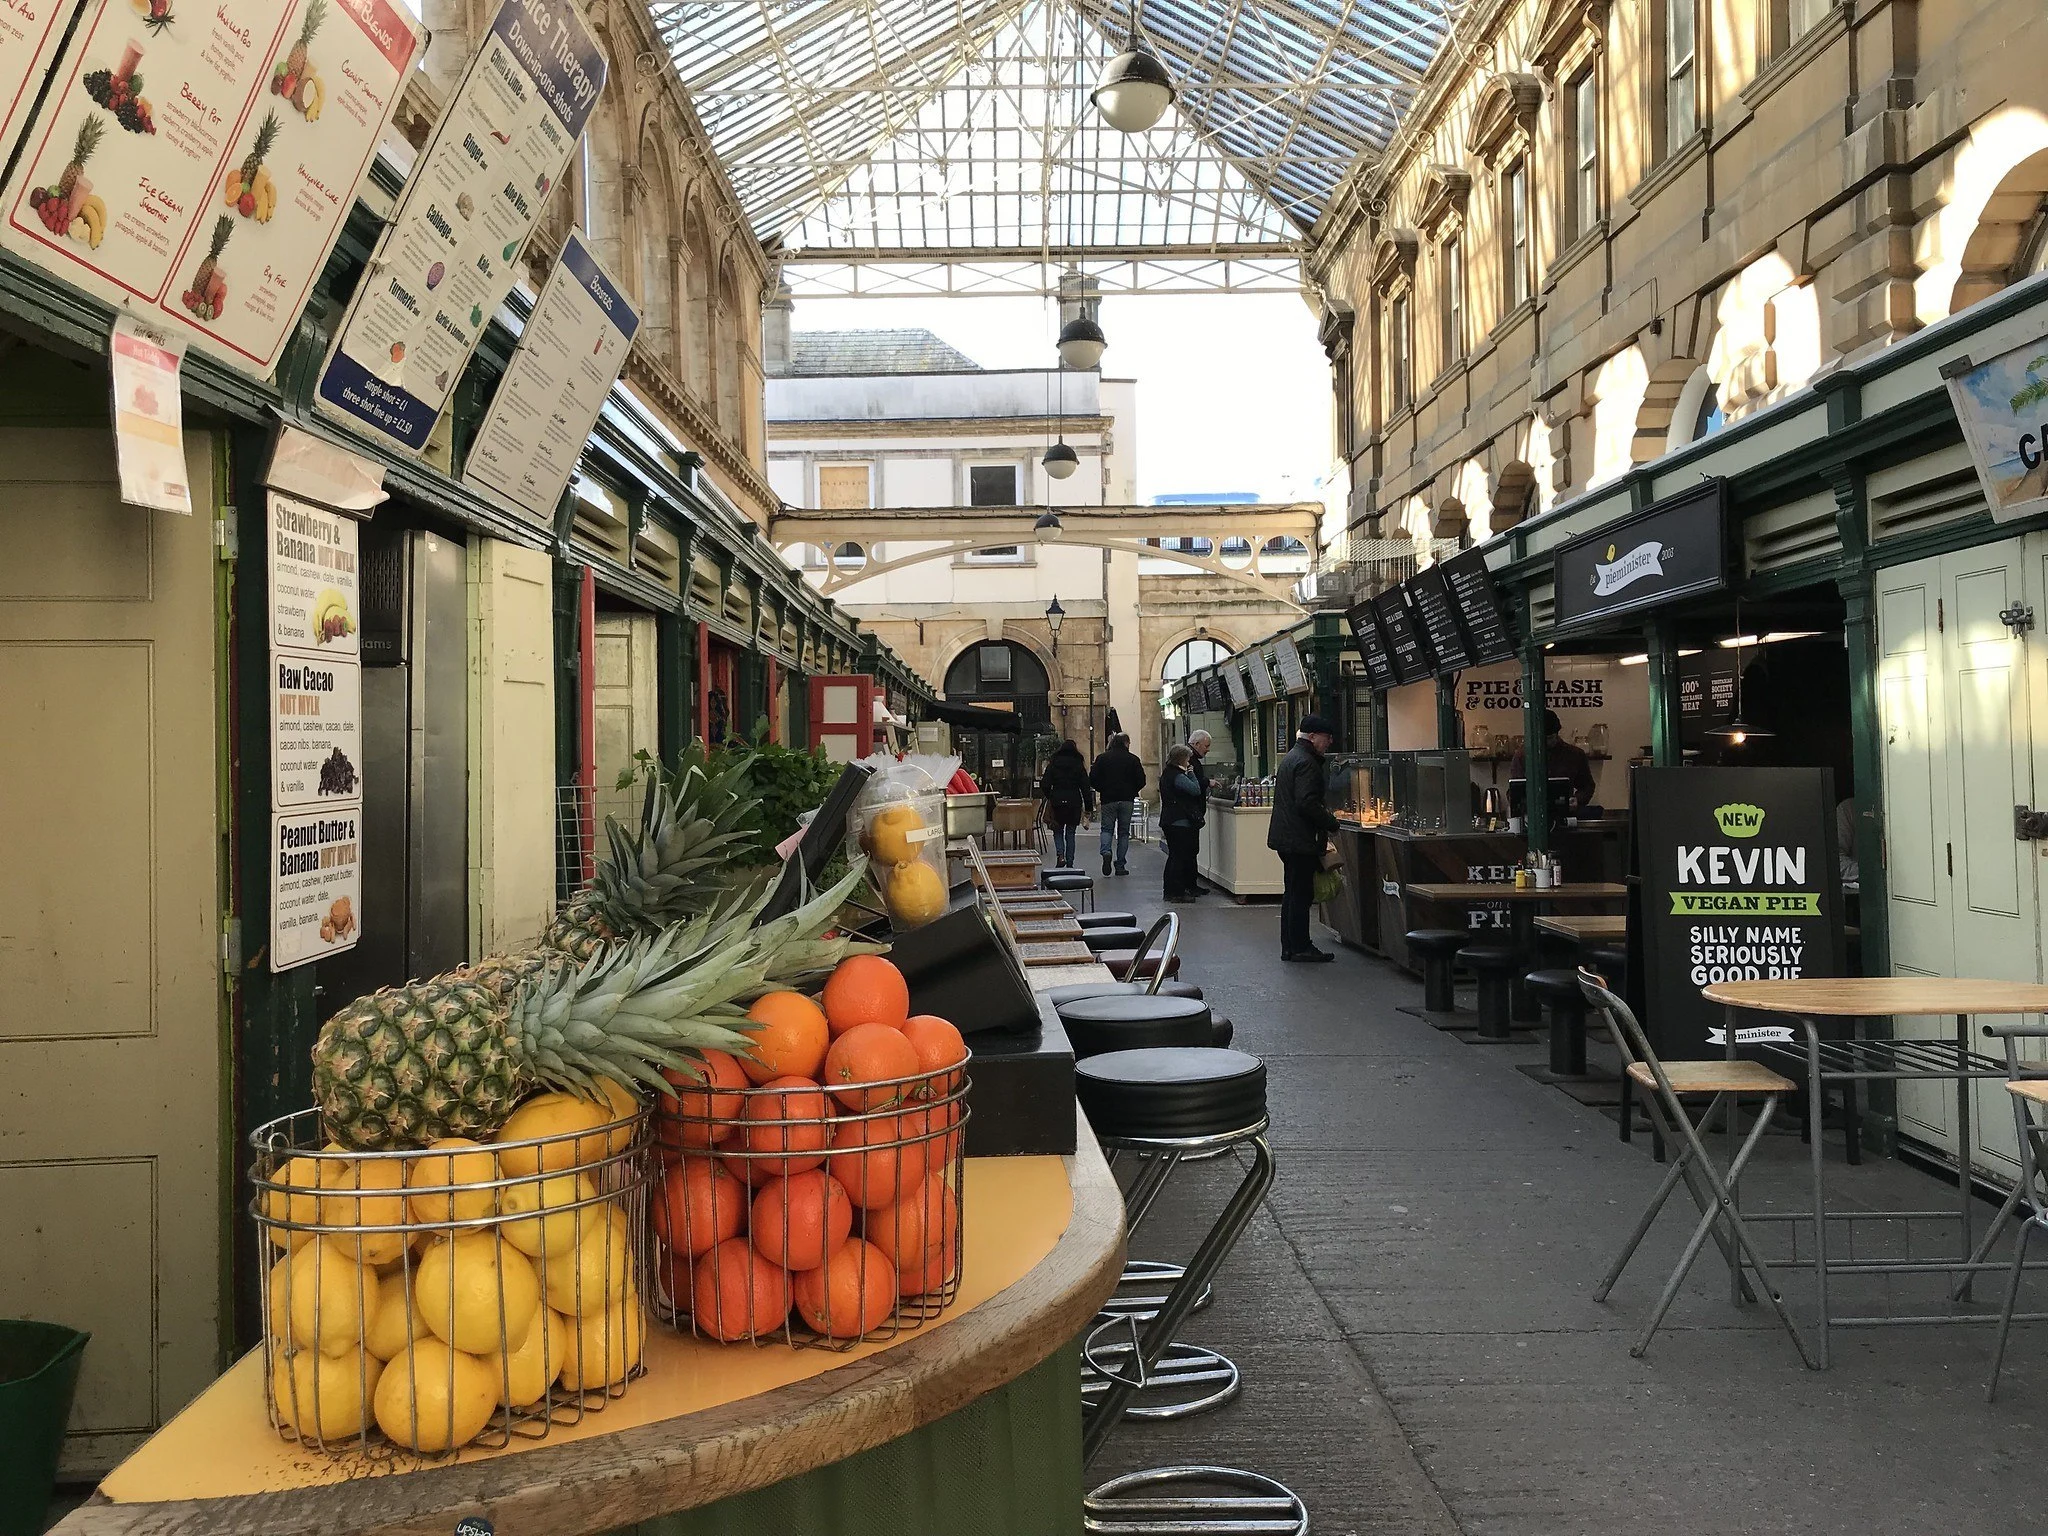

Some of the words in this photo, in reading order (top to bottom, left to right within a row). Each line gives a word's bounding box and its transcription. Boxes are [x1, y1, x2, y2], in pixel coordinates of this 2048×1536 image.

[361, 0, 393, 51] BLENDS
[508, 19, 556, 98] Down-in-one
[553, 91, 574, 123] shots
[550, 18, 596, 110] Therapy
[507, 71, 524, 97] Lime
[463, 132, 484, 163] Ginger
[138, 176, 157, 198] ICE
[158, 190, 184, 219] CREAM
[139, 196, 170, 224] SMOOTHIE
[503, 181, 519, 203] Aloe
[514, 192, 529, 216] Vera
[426, 203, 453, 241] Cabbage
[388, 276, 417, 312] Turmeric
[450, 323, 467, 345] Lemon
[364, 378, 383, 397] single
[381, 389, 396, 405] shot
[342, 386, 361, 405] three
[359, 397, 375, 413] shot
[372, 403, 385, 419] line
[383, 412, 393, 427] up
[275, 502, 332, 545] Strawberry
[333, 524, 341, 546] &
[276, 530, 316, 565] Banana
[1605, 552, 1652, 589] pieminister
[277, 623, 283, 635] &
[283, 623, 305, 638] banana
[360, 638, 392, 649] iams
[279, 663, 301, 690] Raw
[303, 665, 334, 692] Cacao
[1466, 681, 1510, 695] PIE
[279, 693, 297, 716] NUT
[1465, 696, 1480, 710] &
[1483, 697, 1525, 709] GOO
[1682, 701, 1700, 711] MEAT
[279, 740, 297, 751] cacao
[280, 781, 286, 793] &
[286, 780, 305, 793] vanilla
[1722, 812, 1758, 828] NEW
[280, 822, 317, 850] Peanut
[318, 820, 348, 844] Butter
[349, 820, 355, 839] &
[279, 850, 319, 877] Banana
[1677, 846, 1806, 885] KEVIN
[322, 872, 340, 886] peanut
[279, 896, 301, 911] coconut
[1680, 895, 1759, 911] VEGAN
[1765, 896, 1808, 911] PIE
[1467, 910, 1512, 929] PI
[1689, 926, 1739, 944] SILLY
[1746, 926, 1806, 944] NAME.
[1690, 945, 1803, 966] SERIOUSLY
[1690, 966, 1760, 986] GOOD
